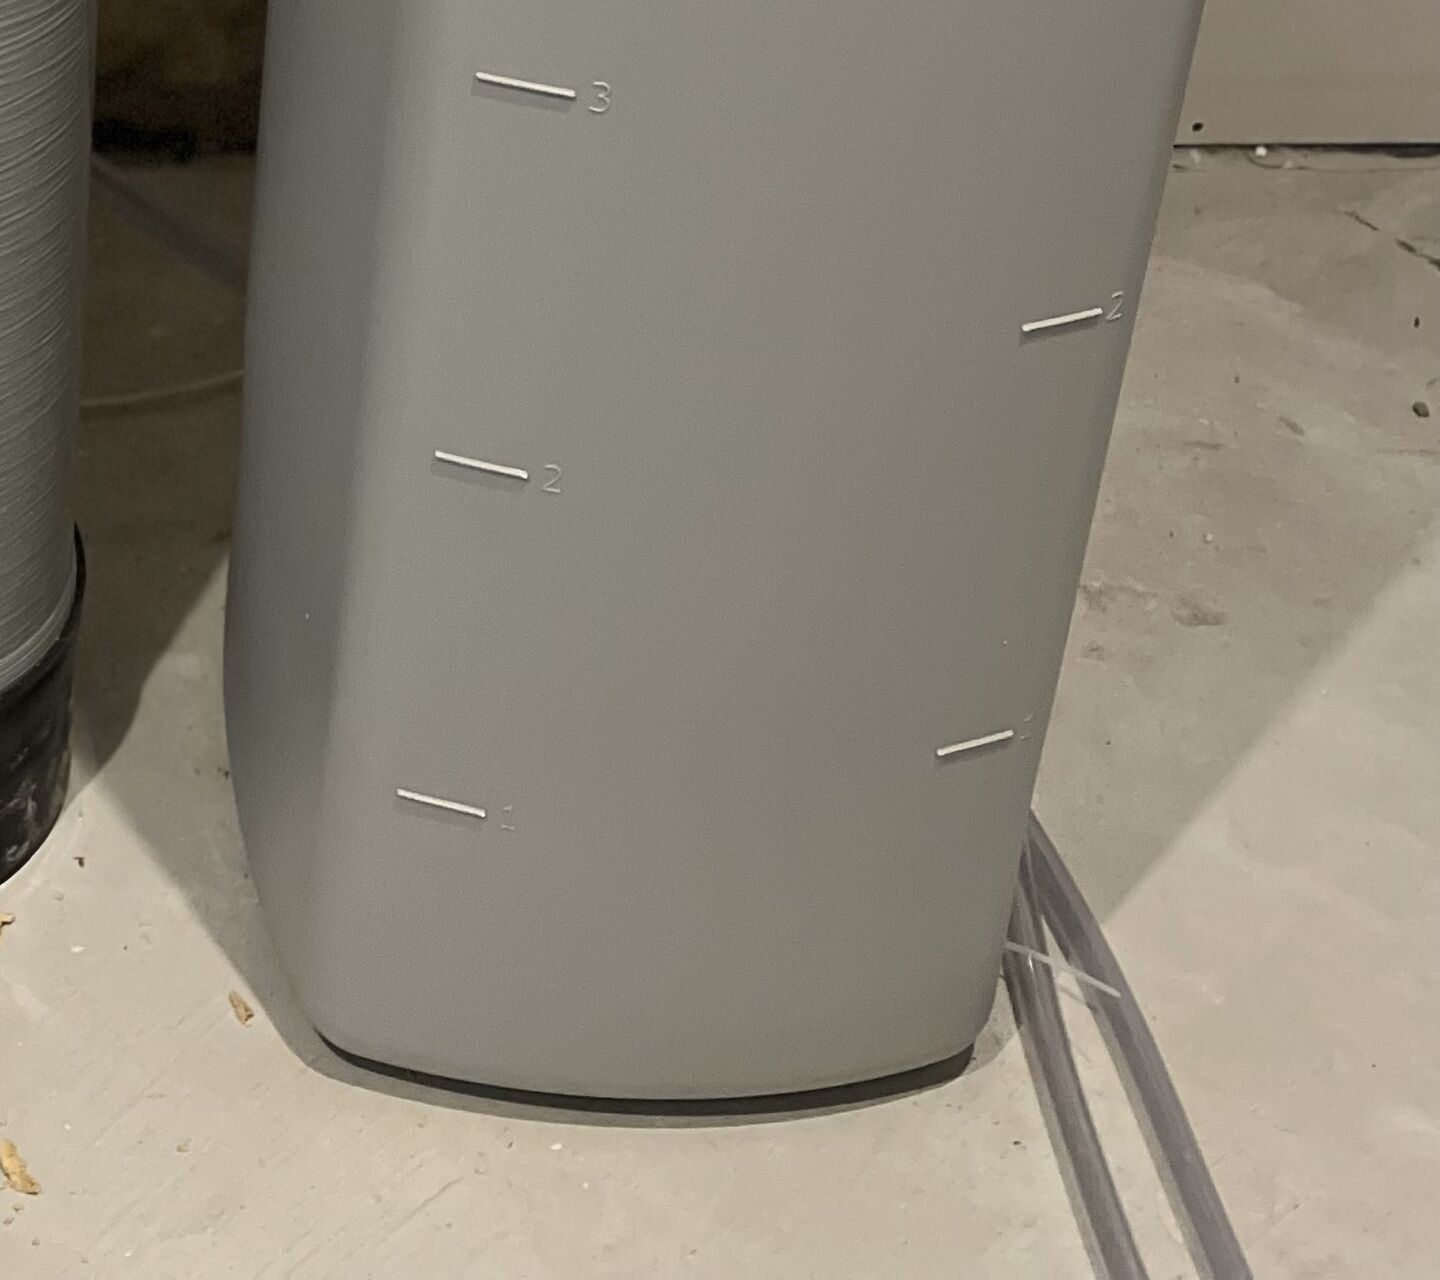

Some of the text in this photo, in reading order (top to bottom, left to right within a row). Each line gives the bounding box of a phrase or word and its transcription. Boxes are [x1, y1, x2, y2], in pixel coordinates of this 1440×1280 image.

[588, 81, 611, 113] 3
[1105, 290, 1124, 323] 2
[542, 463, 562, 494] 2
